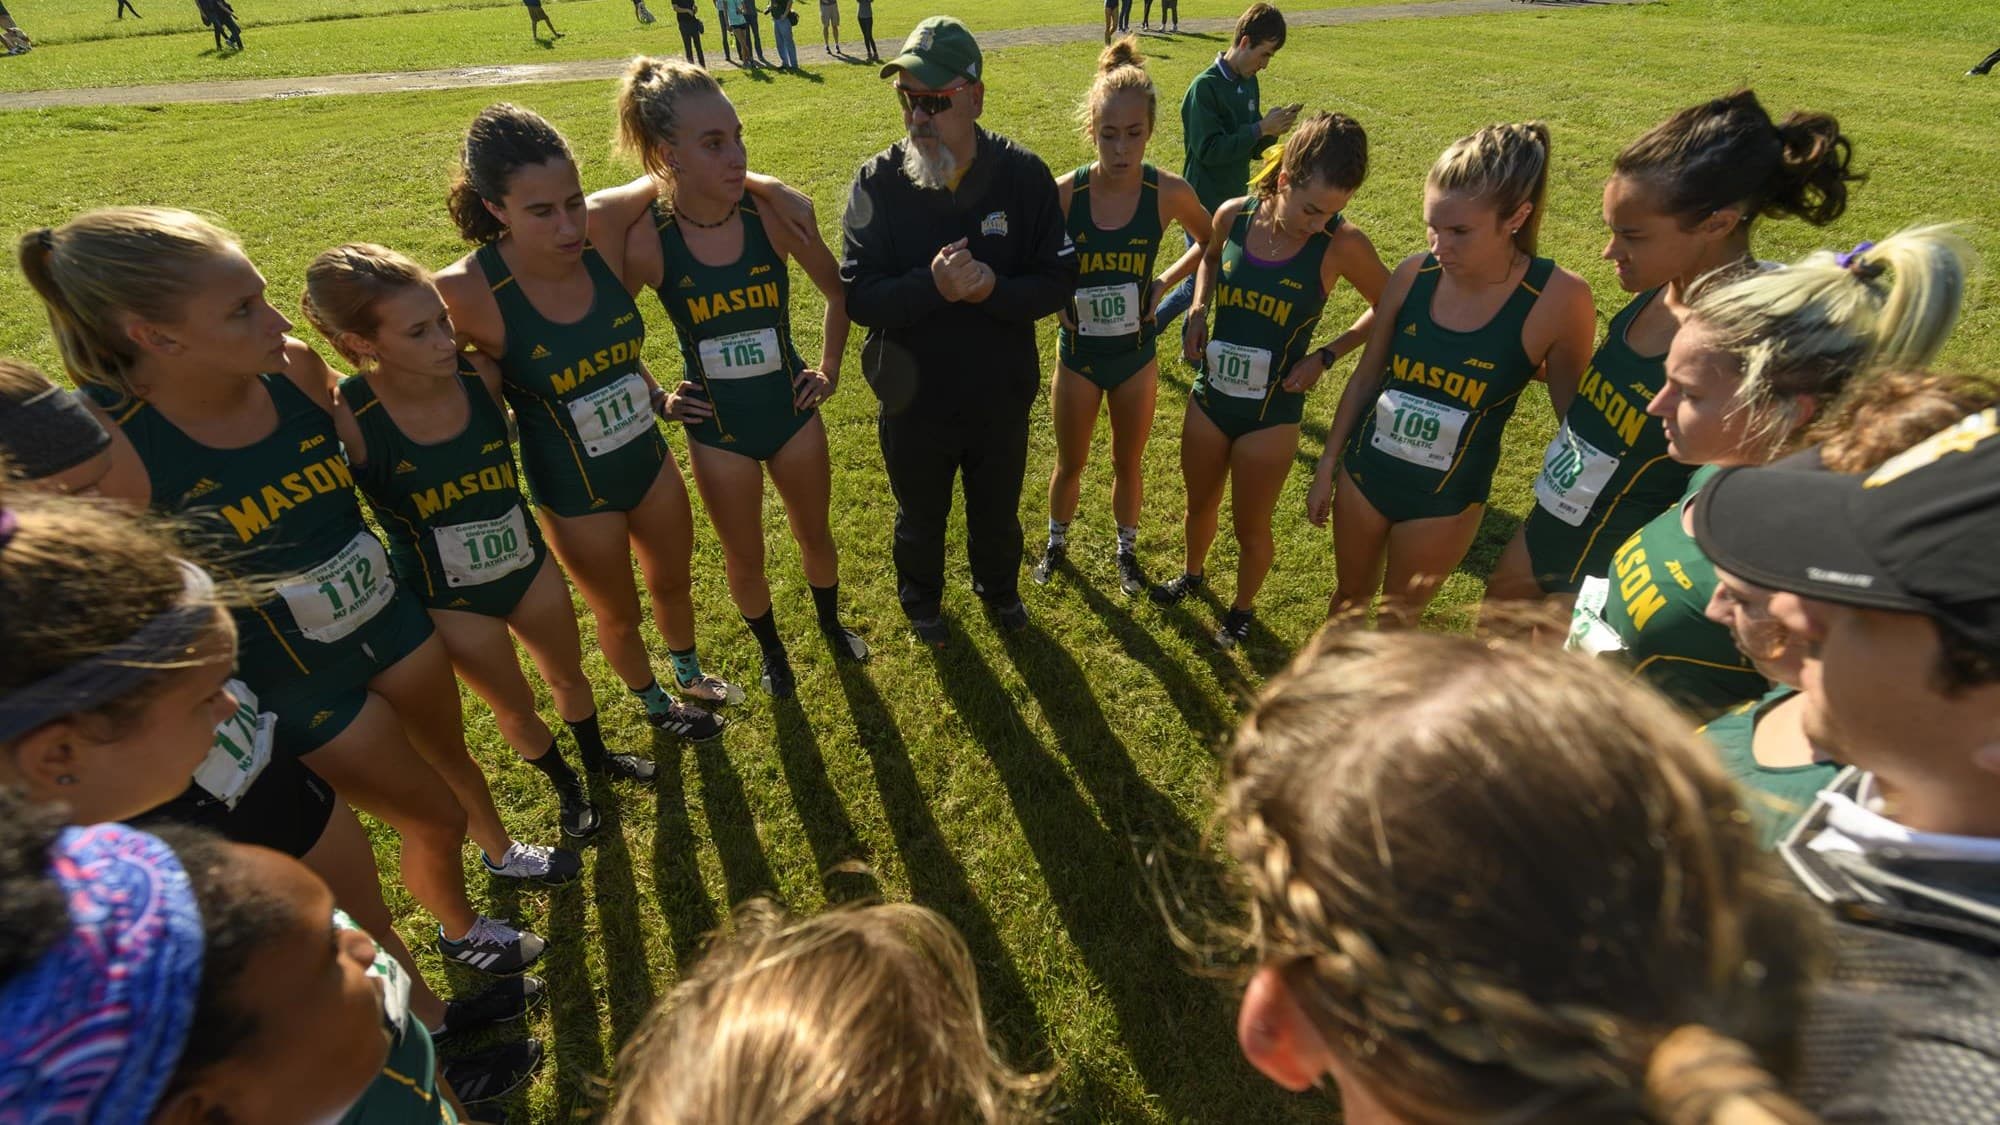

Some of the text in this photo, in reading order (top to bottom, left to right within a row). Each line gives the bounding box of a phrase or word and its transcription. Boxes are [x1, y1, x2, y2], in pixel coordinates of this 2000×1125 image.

[1079, 252, 1147, 277] MASON
[687, 282, 779, 324] MASON
[1089, 295, 1125, 318] 106
[1217, 283, 1293, 327] MASON
[550, 337, 642, 395] MASON
[719, 344, 765, 367] 105
[1217, 354, 1251, 379] 101
[1392, 354, 1488, 409] MASON
[594, 392, 635, 428] 111
[1394, 408, 1440, 442] 109
[220, 454, 353, 544] MASON
[410, 461, 515, 520] MASON
[463, 528, 518, 563] 100
[319, 557, 377, 611] 112
[1664, 559, 1694, 590] A10
